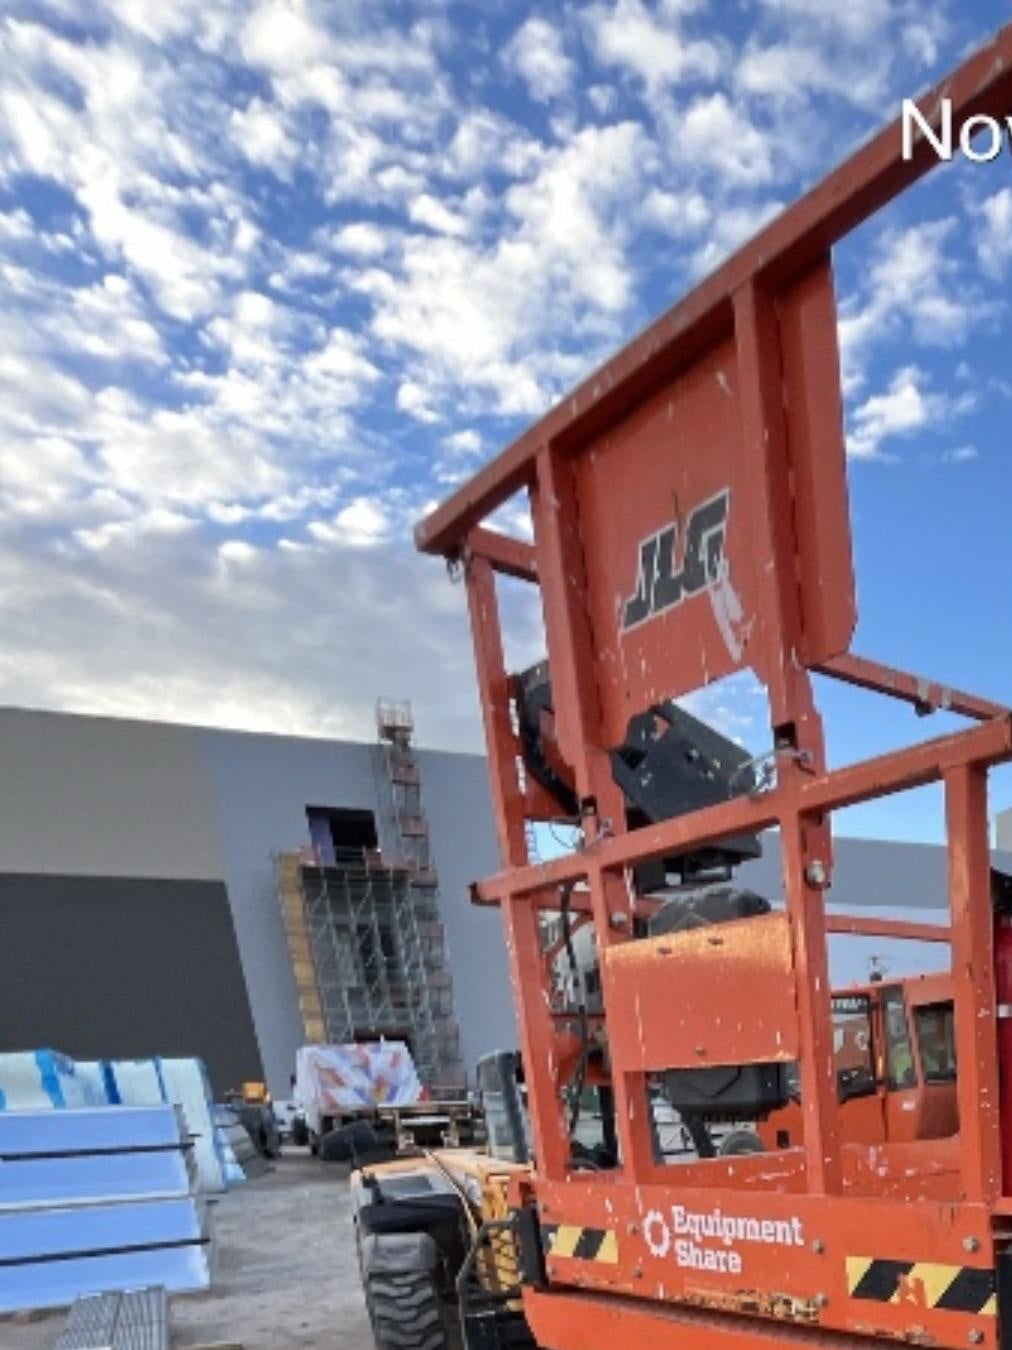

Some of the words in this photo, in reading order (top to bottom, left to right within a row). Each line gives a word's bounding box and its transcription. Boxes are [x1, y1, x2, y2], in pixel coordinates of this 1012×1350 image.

[620, 484, 732, 634] JLG
[671, 1205, 806, 1247] Equipment
[673, 1238, 743, 1274] Share
